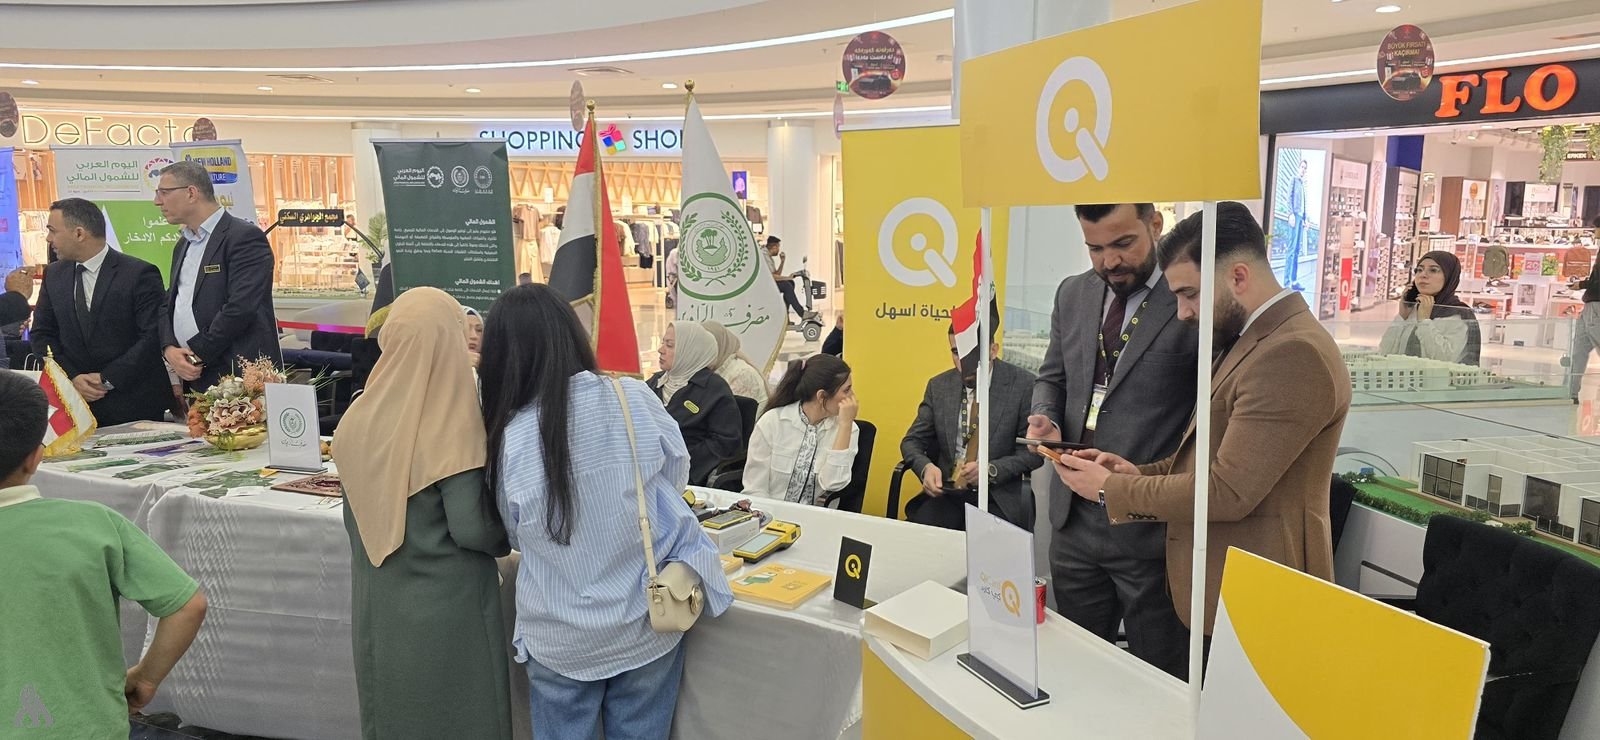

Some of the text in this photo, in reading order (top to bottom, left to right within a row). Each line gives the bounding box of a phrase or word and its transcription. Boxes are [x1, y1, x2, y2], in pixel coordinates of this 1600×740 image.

[1434, 64, 1577, 118] FLO
[76, 160, 138, 171] اليوم العربي
[207, 156, 232, 166] HOLLAND
[66, 171, 139, 184] للشمول المالي
[875, 302, 916, 320] اسهل
[724, 304, 770, 334] مصرف
